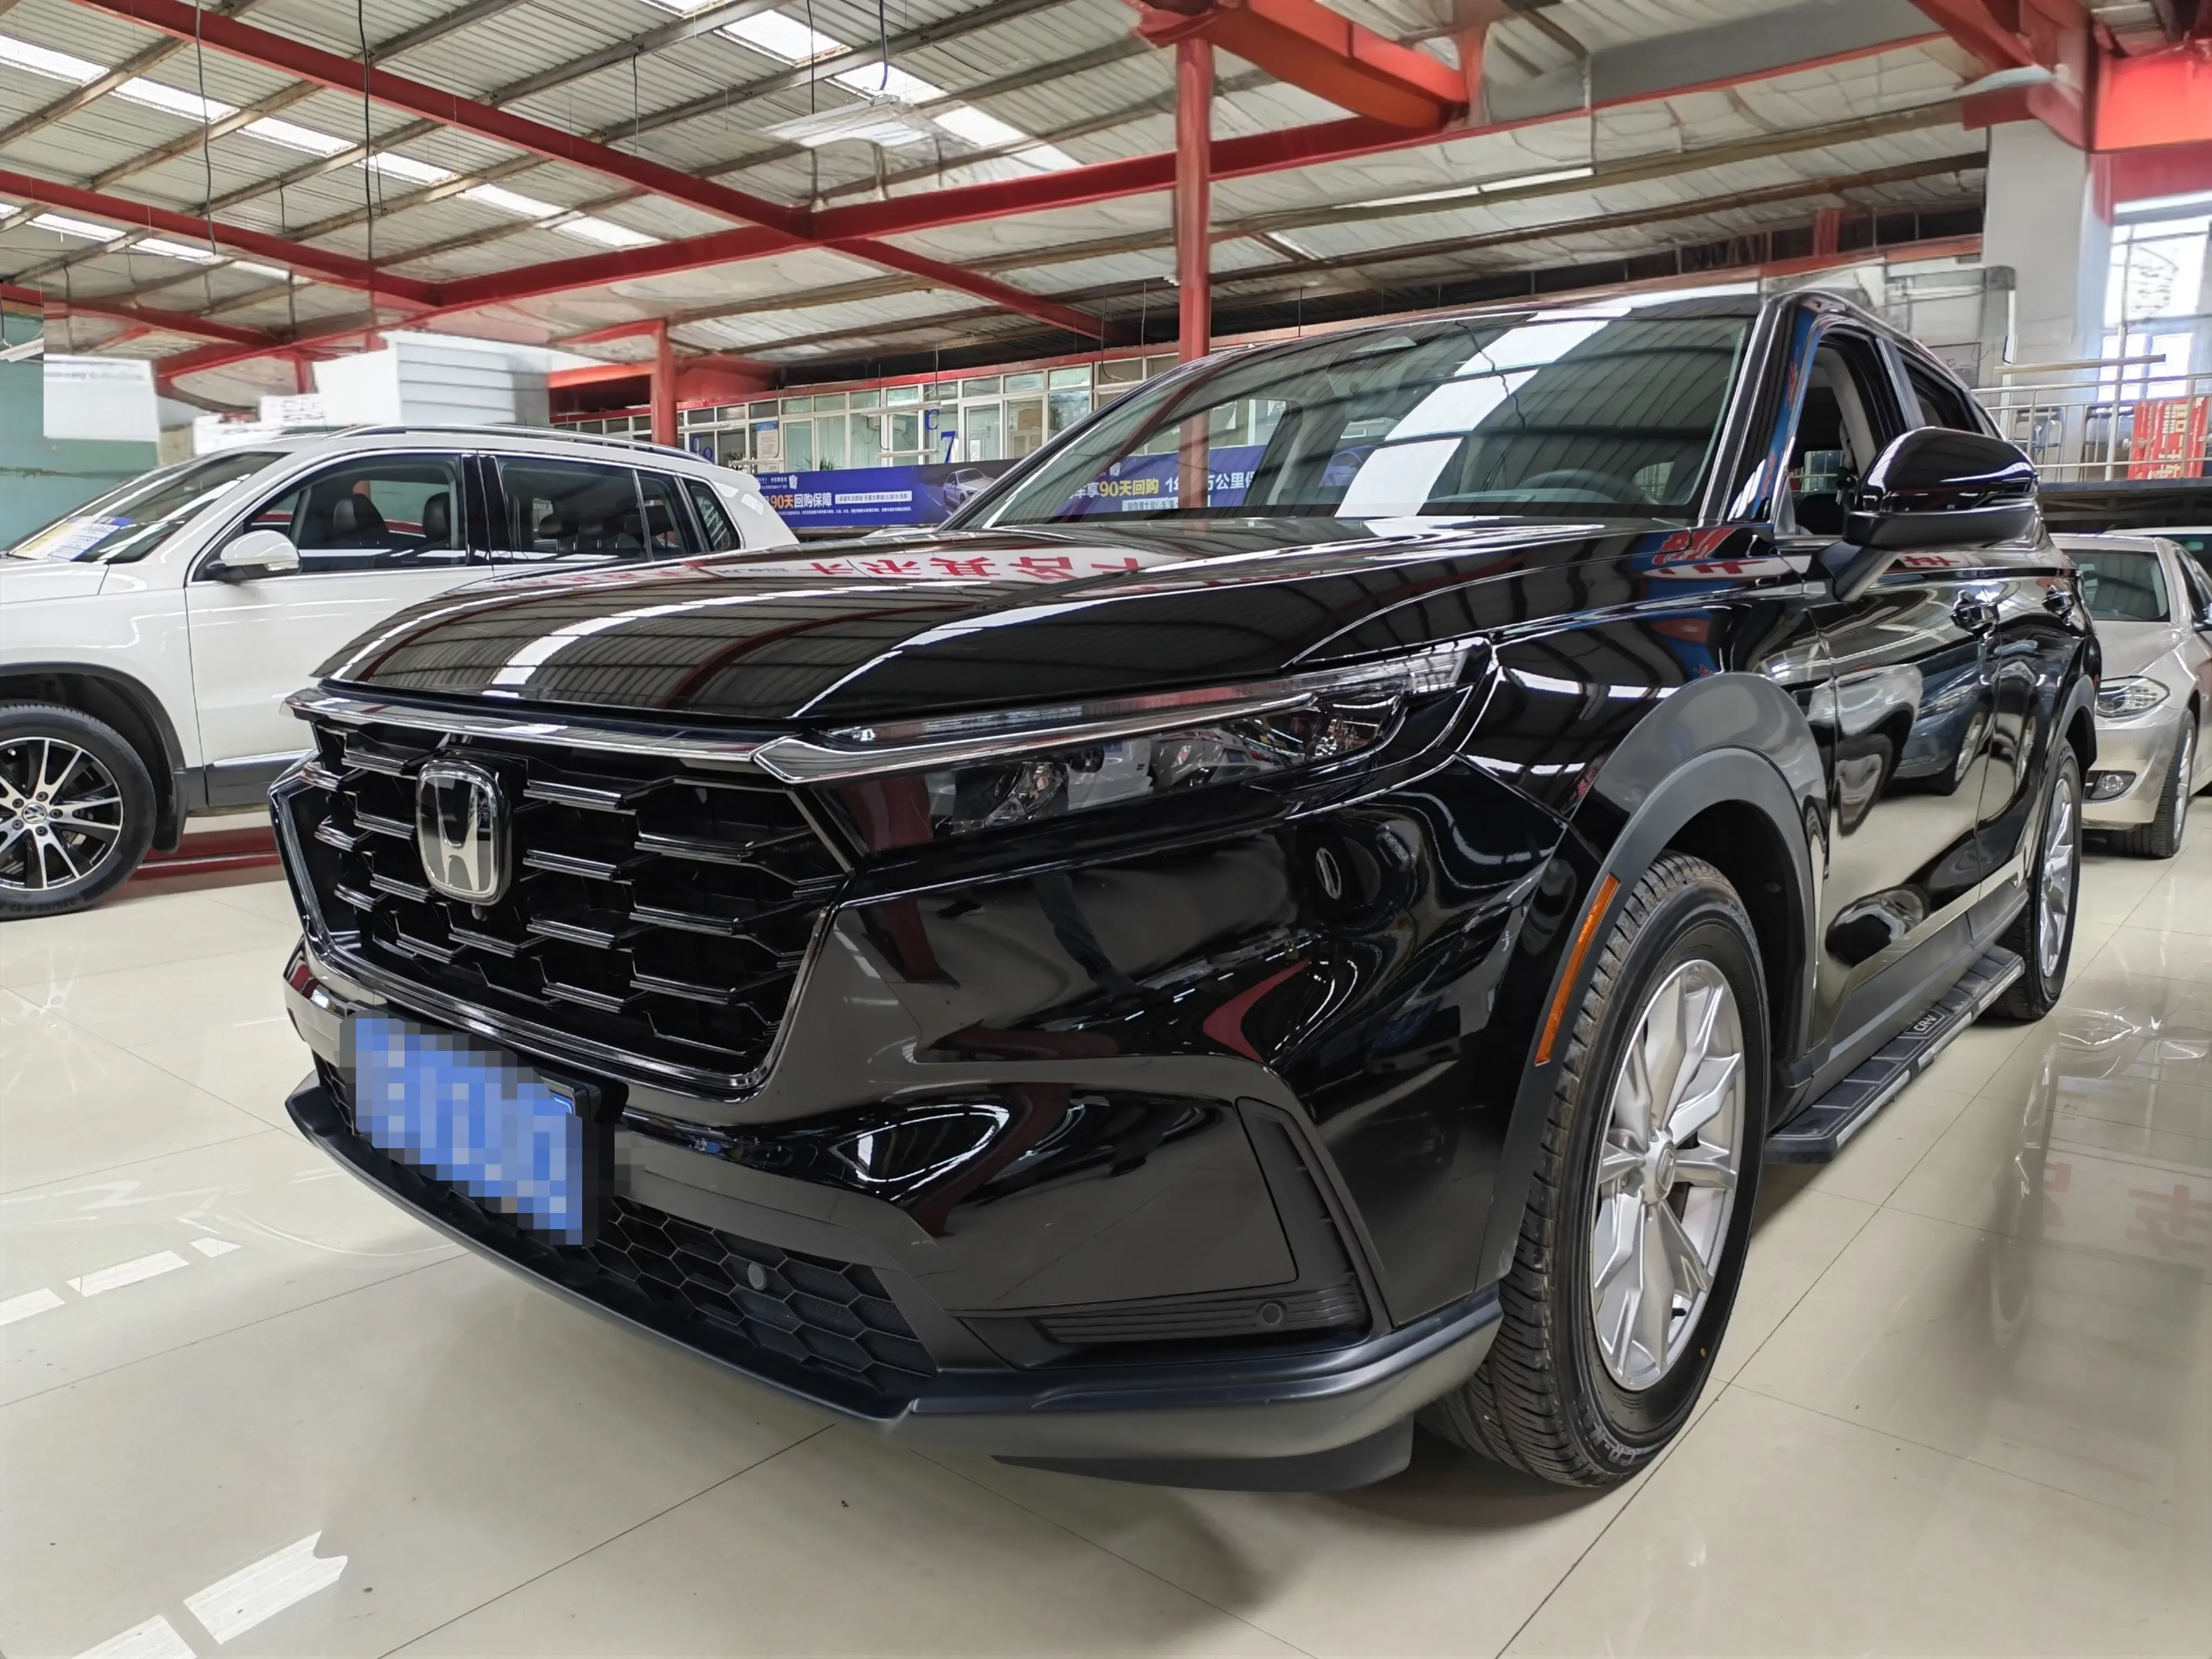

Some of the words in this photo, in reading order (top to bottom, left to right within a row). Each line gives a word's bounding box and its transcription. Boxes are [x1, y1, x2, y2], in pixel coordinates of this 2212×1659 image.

[1069, 478, 1159, 499] 车享90天回购
[1913, 1014, 1937, 1031] CR-V
